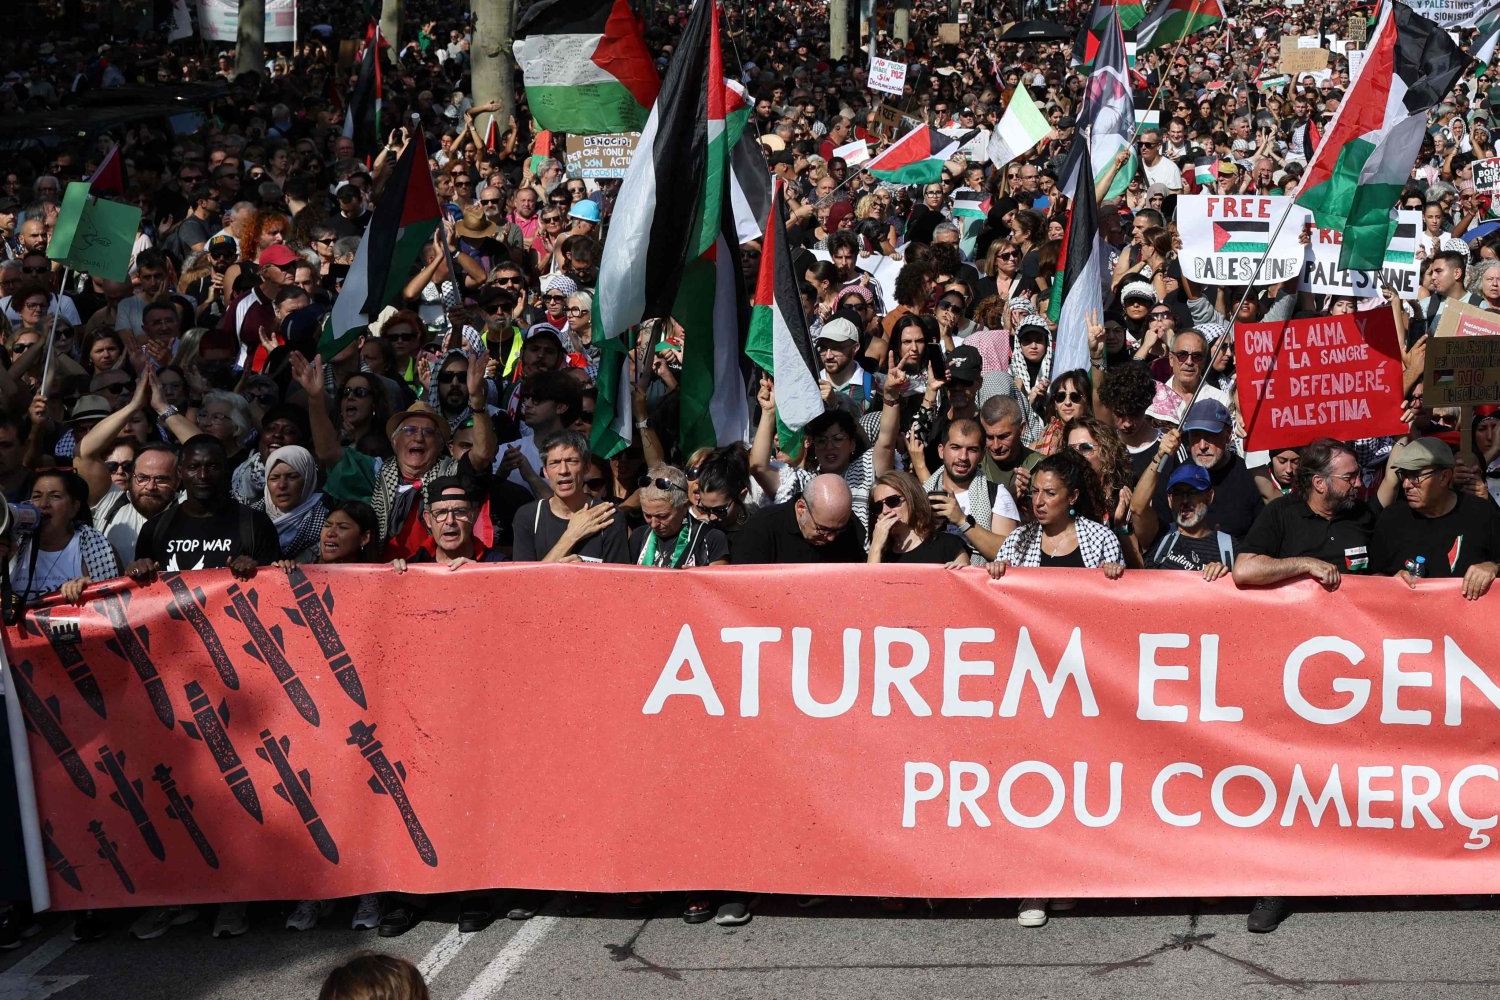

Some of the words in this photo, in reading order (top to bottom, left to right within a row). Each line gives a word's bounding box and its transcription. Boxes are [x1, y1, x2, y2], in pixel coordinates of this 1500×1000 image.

[1425, 0, 1474, 10] PALESTINOS
[1434, 12, 1474, 21] SIONISMO
[567, 151, 582, 163] PER
[567, 160, 582, 173] ON
[1476, 177, 1482, 185] A
[1207, 197, 1272, 219] FREE
[1305, 222, 1343, 245] FRE
[1194, 257, 1298, 282] PALESTINE
[1244, 330, 1274, 355] CON
[1284, 327, 1301, 350] EL
[1306, 321, 1347, 347] ALMA
[1356, 318, 1368, 341] Y
[1464, 321, 1492, 334] Netanyahu
[1254, 355, 1279, 373] CON
[1289, 351, 1311, 370] LA
[1320, 343, 1369, 365] SANGRE
[1457, 368, 1485, 387] NO
[1251, 378, 1275, 400] TE
[1271, 398, 1372, 429] PALESTINA
[166, 539, 200, 553] STOP
[202, 538, 232, 552] WAR
[642, 623, 1100, 719] ATUREM
[1136, 632, 1244, 723] EL
[901, 760, 1124, 829] PROU
[1151, 762, 1500, 850] COMERÇ
